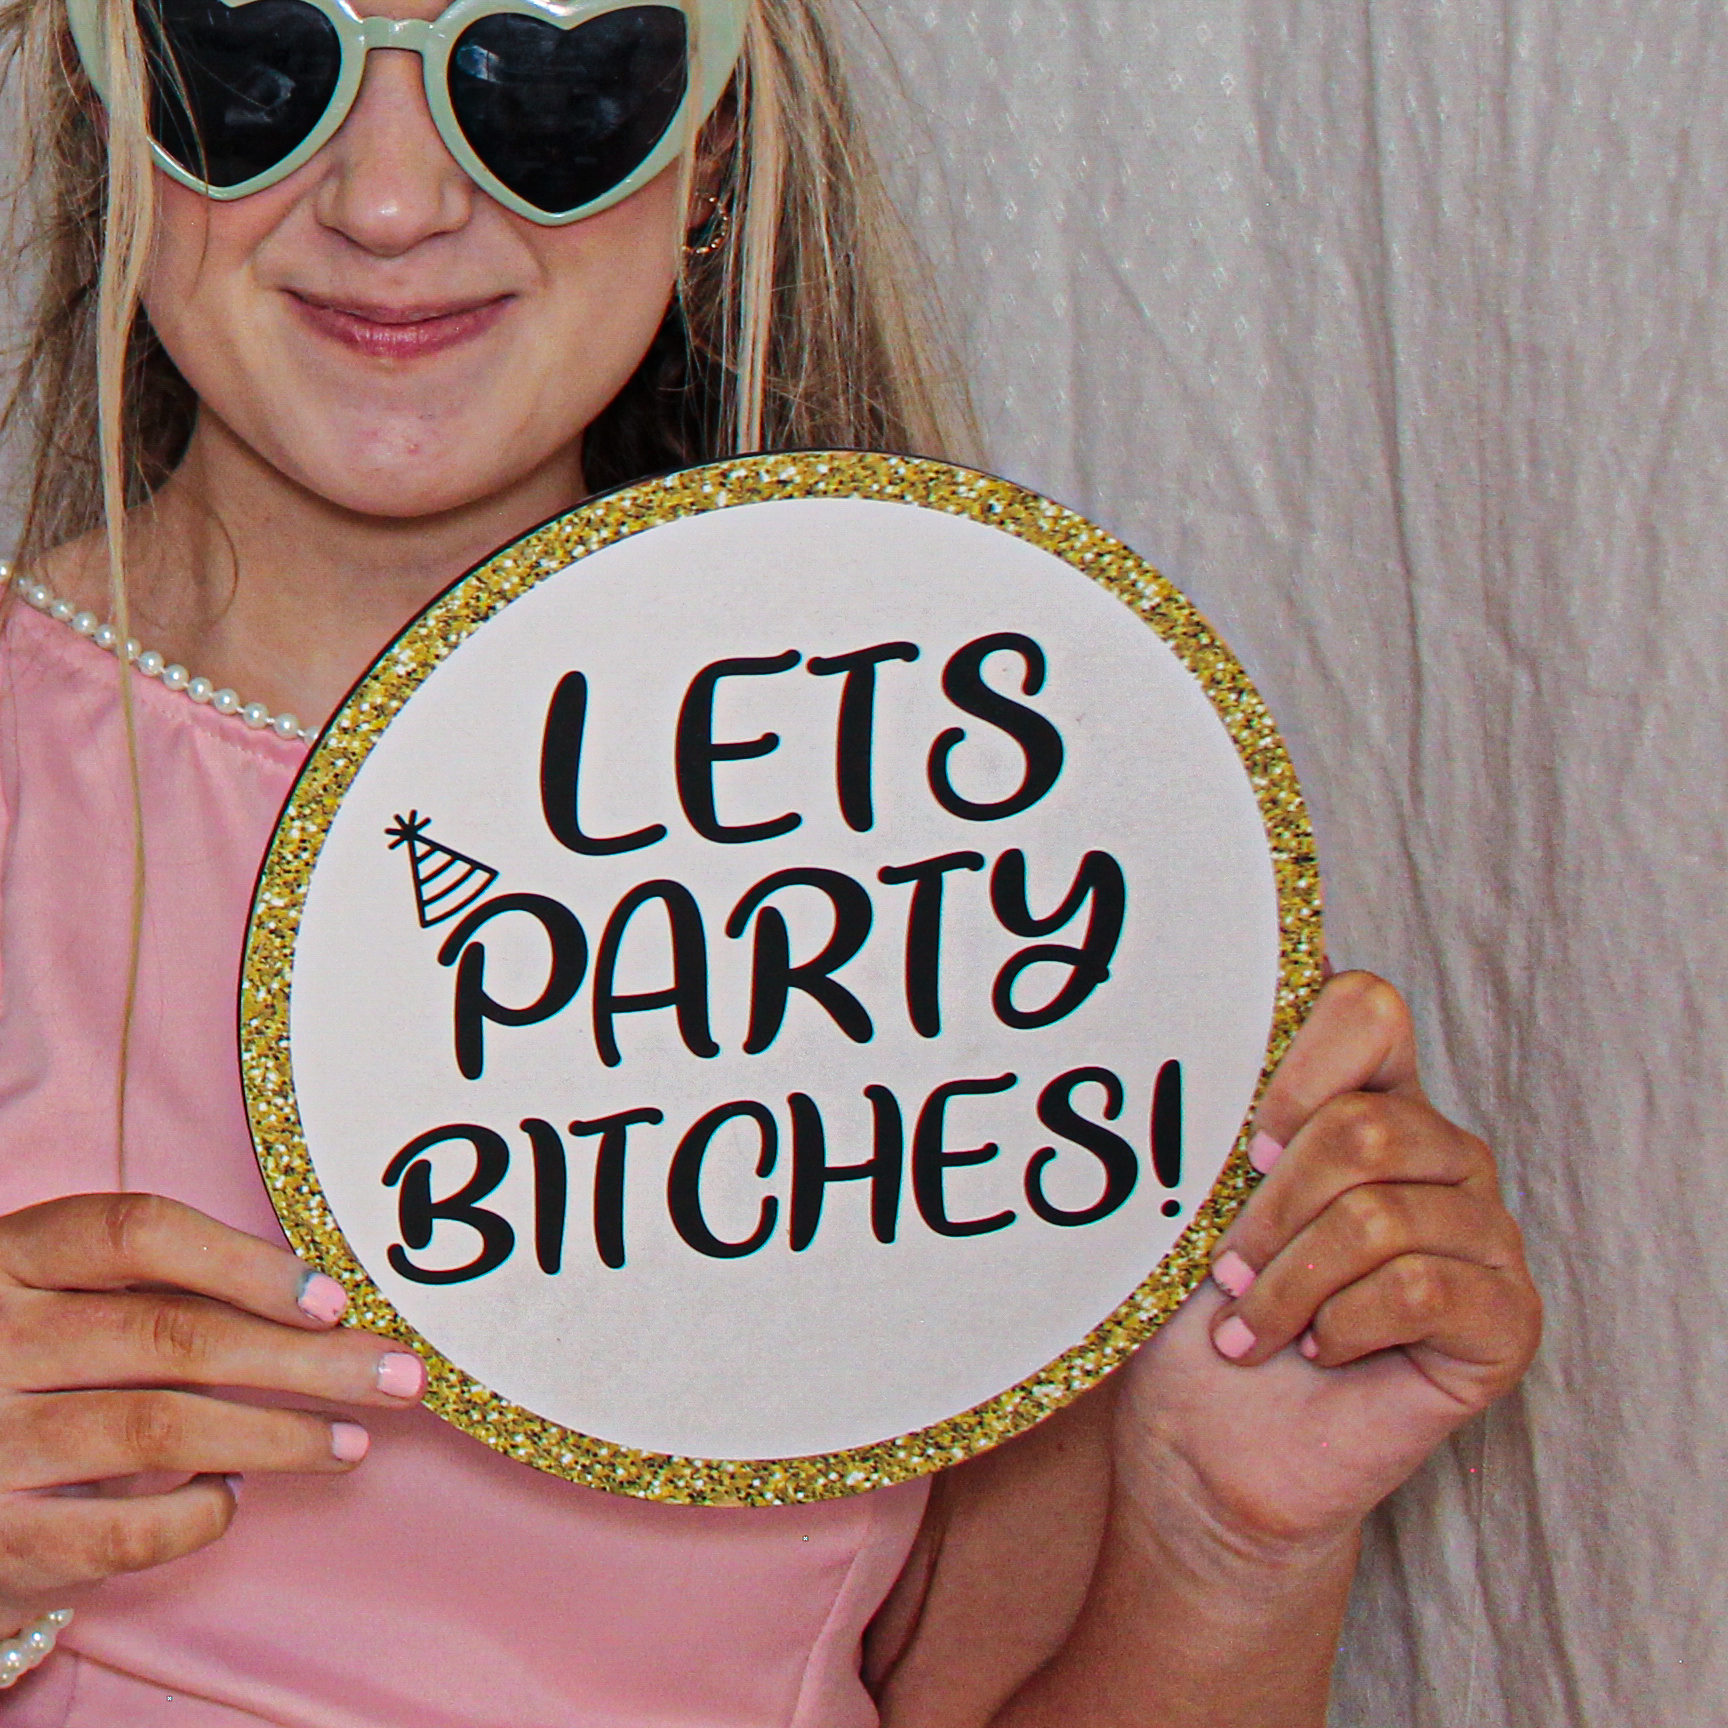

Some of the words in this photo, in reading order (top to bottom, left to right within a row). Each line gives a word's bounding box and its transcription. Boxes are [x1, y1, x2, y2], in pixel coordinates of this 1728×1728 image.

[539, 631, 1065, 856] LETS
[437, 847, 1127, 1081] PARTY
[381, 1058, 1184, 1286] BITCHES!
